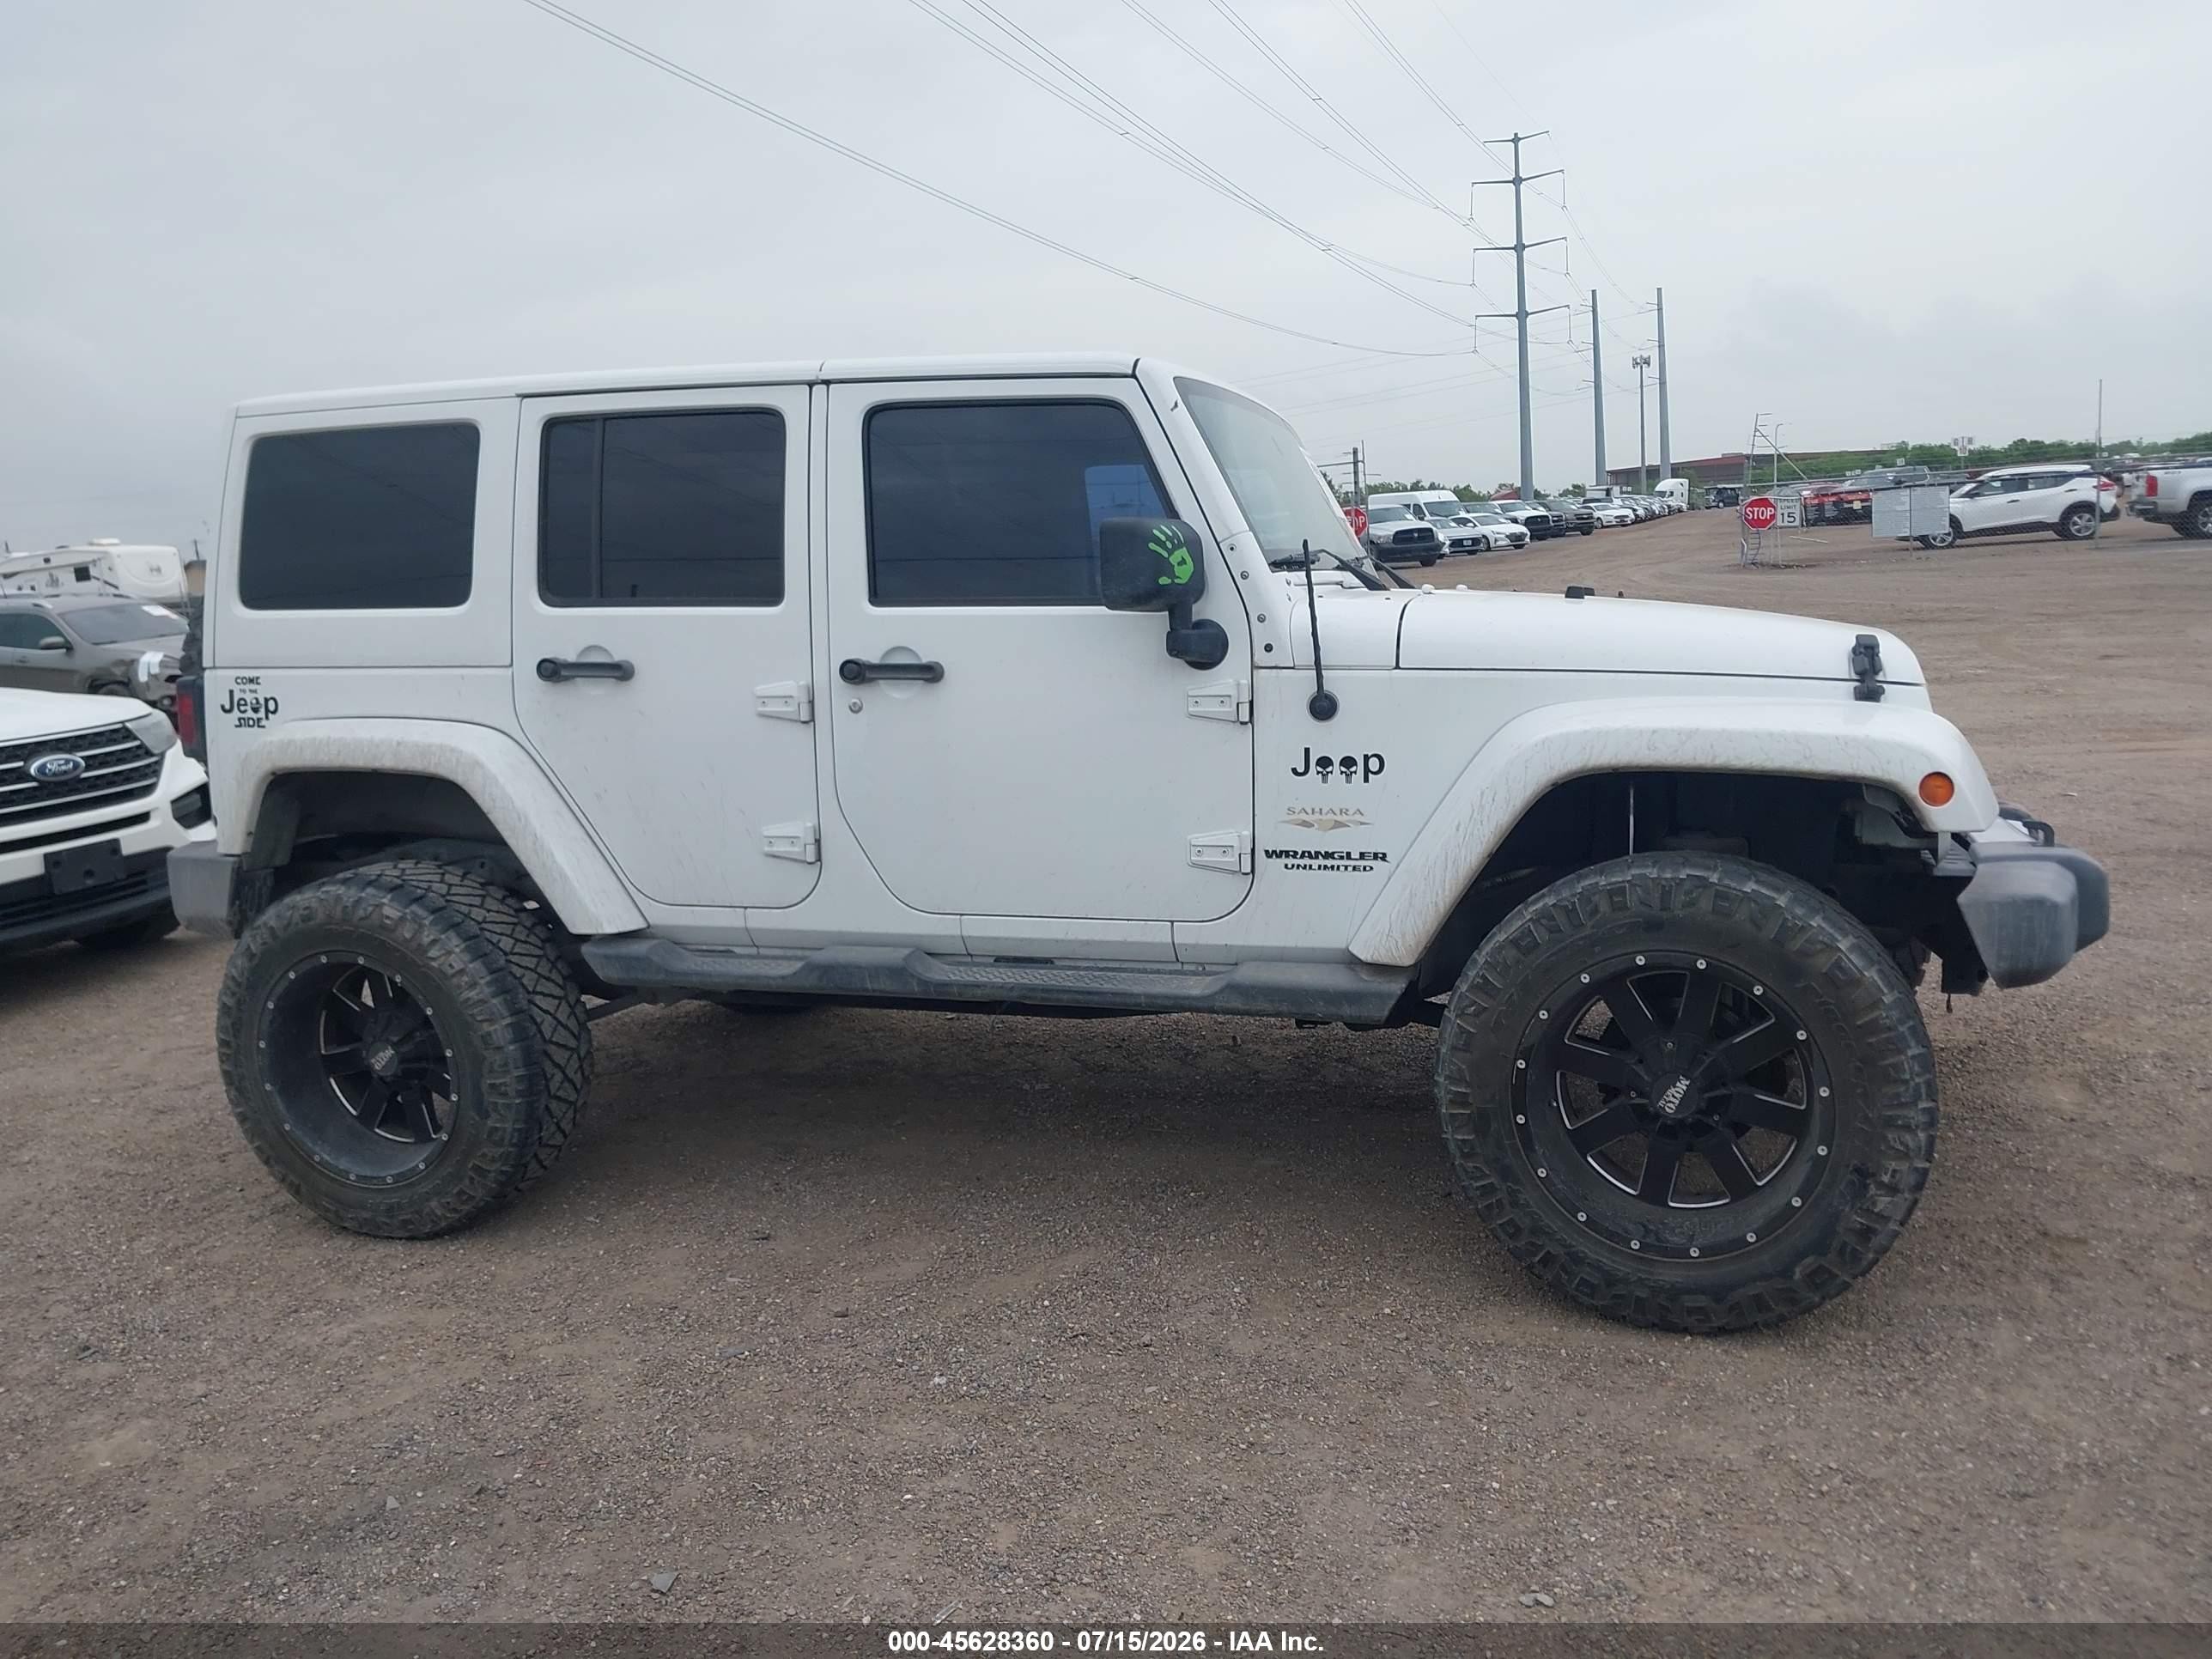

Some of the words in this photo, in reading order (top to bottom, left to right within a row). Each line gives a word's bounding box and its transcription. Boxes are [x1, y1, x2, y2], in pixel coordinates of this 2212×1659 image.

[1746, 507, 1775, 520] STOP
[1780, 512, 1796, 524] 15
[234, 676, 261, 685] COME
[1285, 806, 1365, 817] SAHARA
[1263, 849, 1391, 863] WRANGLER
[1284, 863, 1375, 872] UNLIMITED
[1664, 1074, 1691, 1114] MOTO
